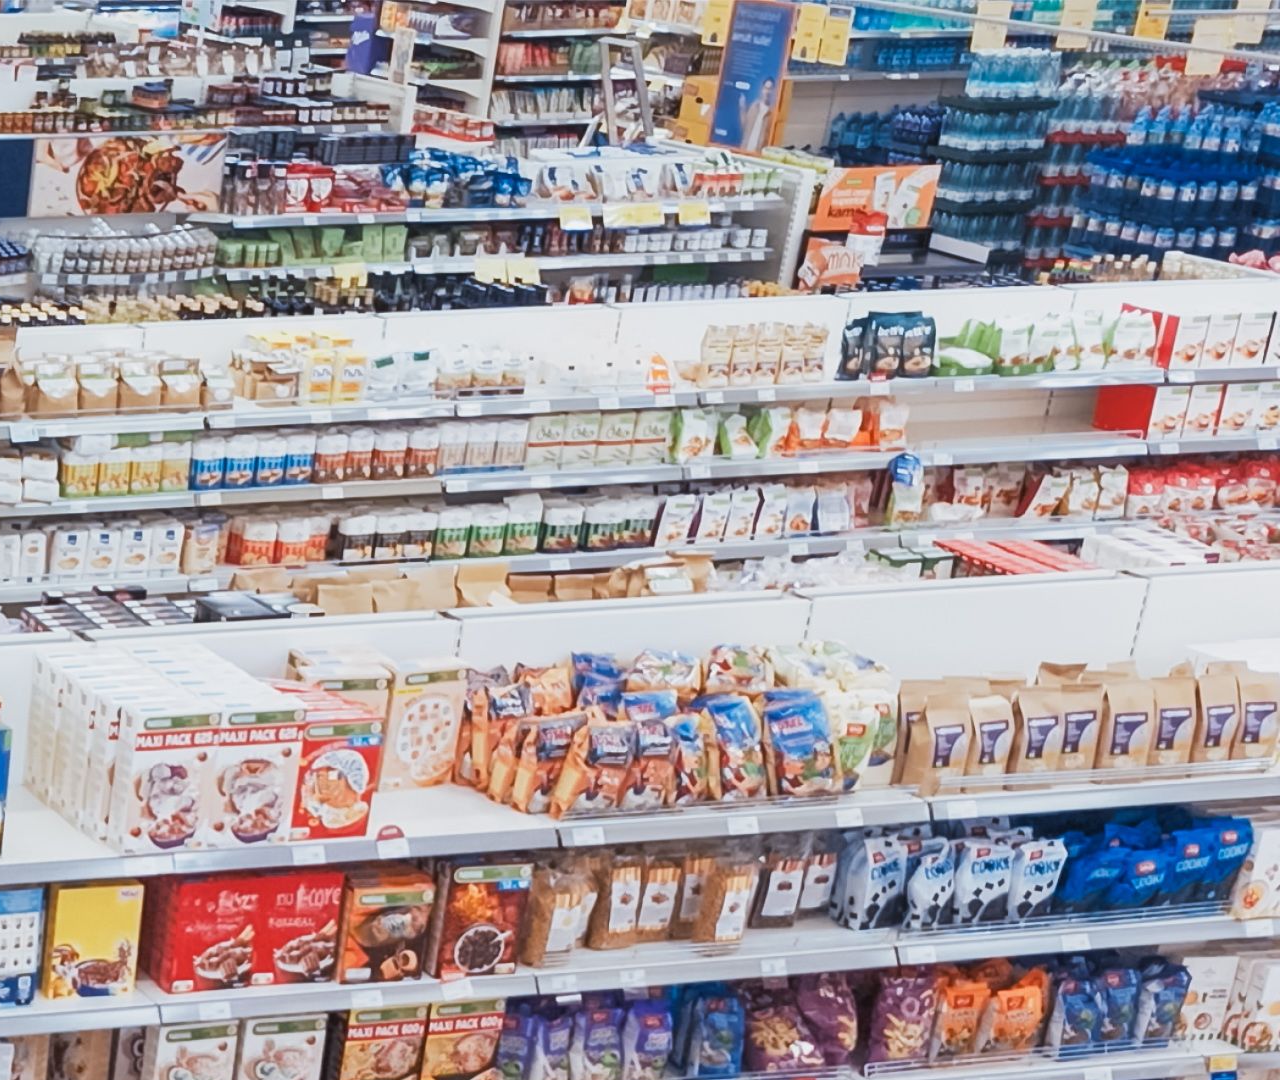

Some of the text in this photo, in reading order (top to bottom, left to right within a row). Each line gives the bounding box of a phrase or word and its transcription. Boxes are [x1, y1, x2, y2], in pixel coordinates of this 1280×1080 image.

[136, 733, 163, 748] MAXI
[165, 731, 191, 746] PACK
[220, 730, 247, 744] MAXI
[249, 728, 276, 742] PACK
[347, 1026, 373, 1038] MAXI
[375, 1024, 399, 1036] PACK
[428, 1020, 454, 1032] MAXI
[455, 1018, 478, 1030] PACK
